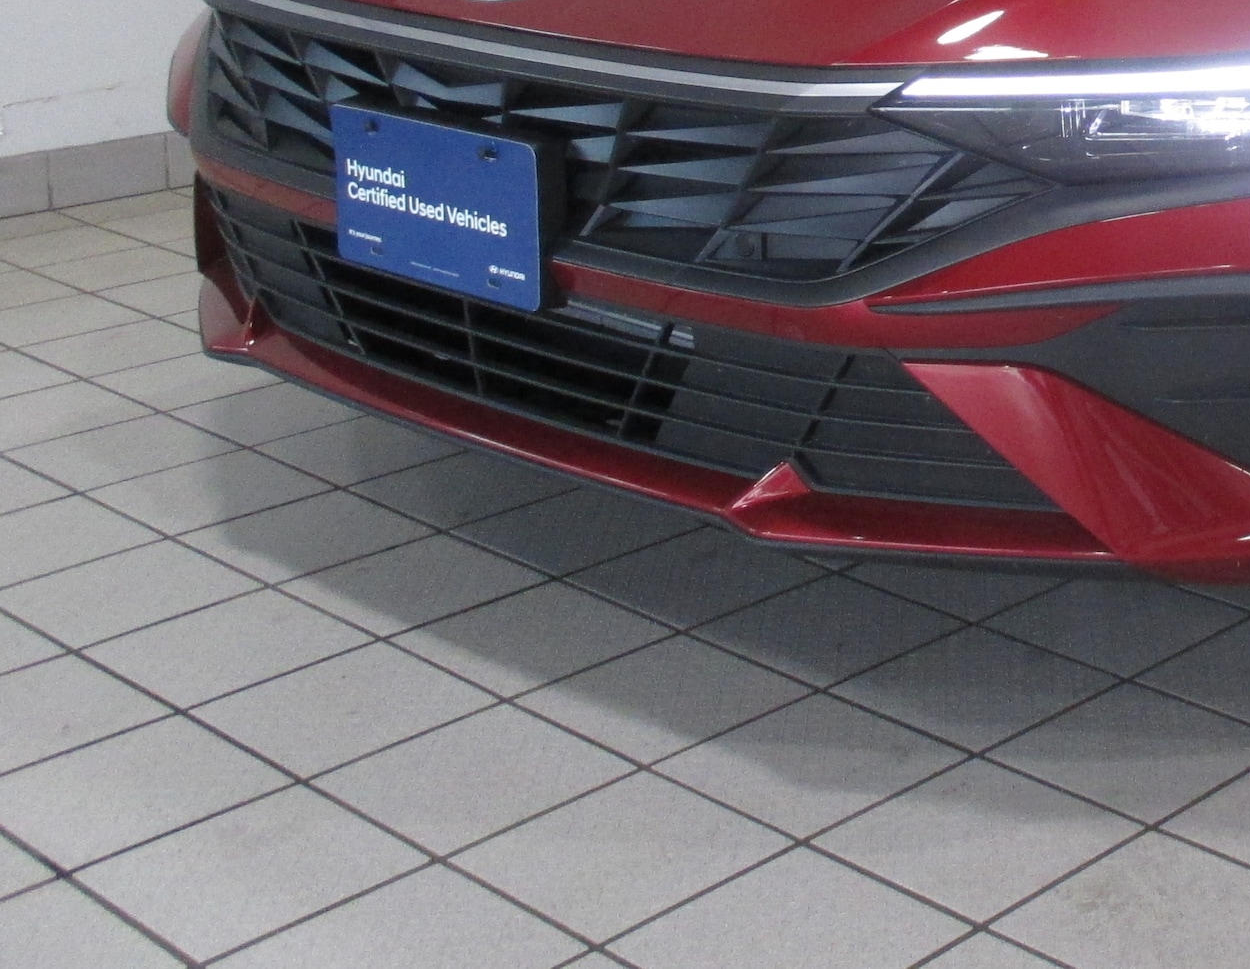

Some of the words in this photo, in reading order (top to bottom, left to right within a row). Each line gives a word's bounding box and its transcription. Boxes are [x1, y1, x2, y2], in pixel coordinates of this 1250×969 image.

[346, 157, 406, 189] Hyundai
[347, 181, 406, 212] Certified
[408, 195, 445, 222] Used
[446, 204, 508, 238] Vehicles
[499, 267, 526, 282] HYUNDAI
